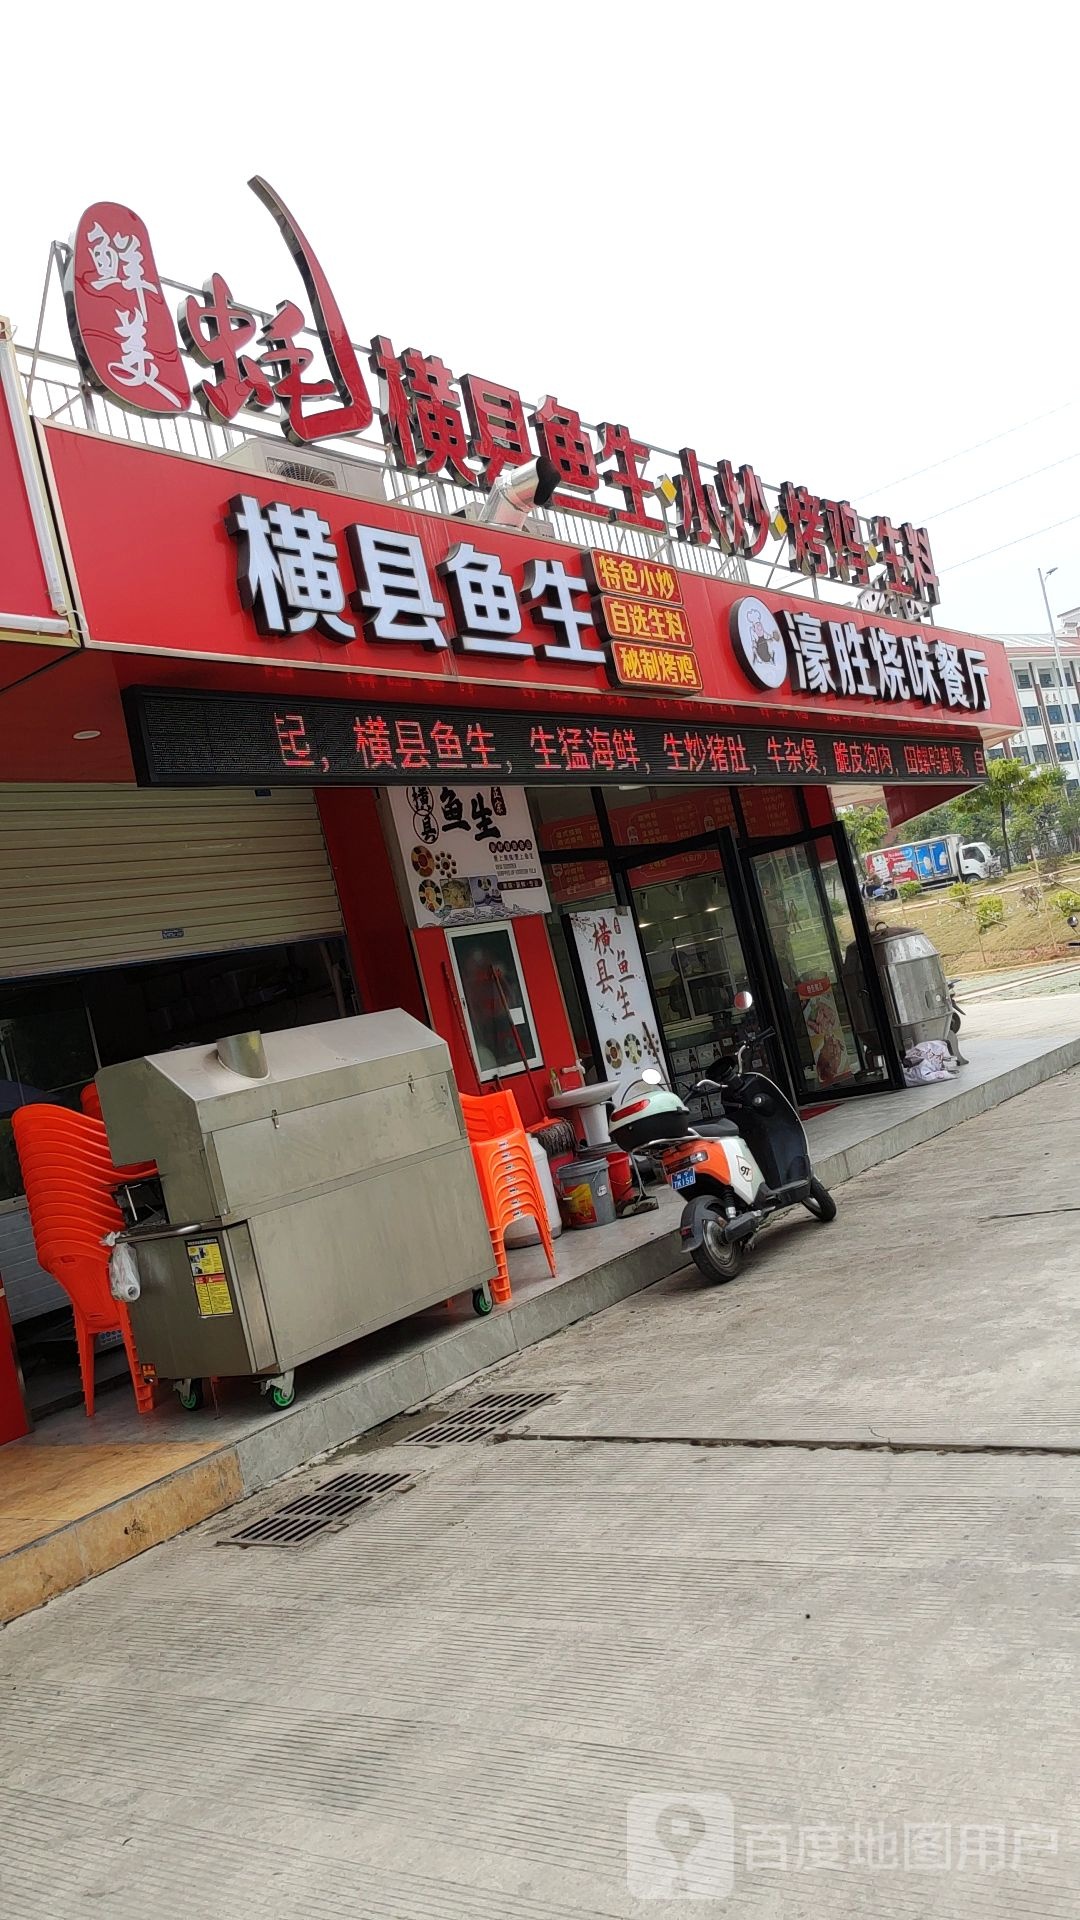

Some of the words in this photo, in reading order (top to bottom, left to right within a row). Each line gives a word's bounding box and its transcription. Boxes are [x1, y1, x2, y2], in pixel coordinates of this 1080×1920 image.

[87, 221, 181, 409] 鲜美
[230, 493, 607, 664] 横县鱼生
[599, 555, 675, 600] 特色小炒
[609, 600, 686, 643] 自选生料
[782, 610, 991, 710] 濠胜烧味餐厅
[620, 646, 697, 685] 秘制烤鸡
[439, 787, 501, 841] 鱼生
[591, 916, 615, 995] 横县
[615, 949, 636, 1020] 鱼生
